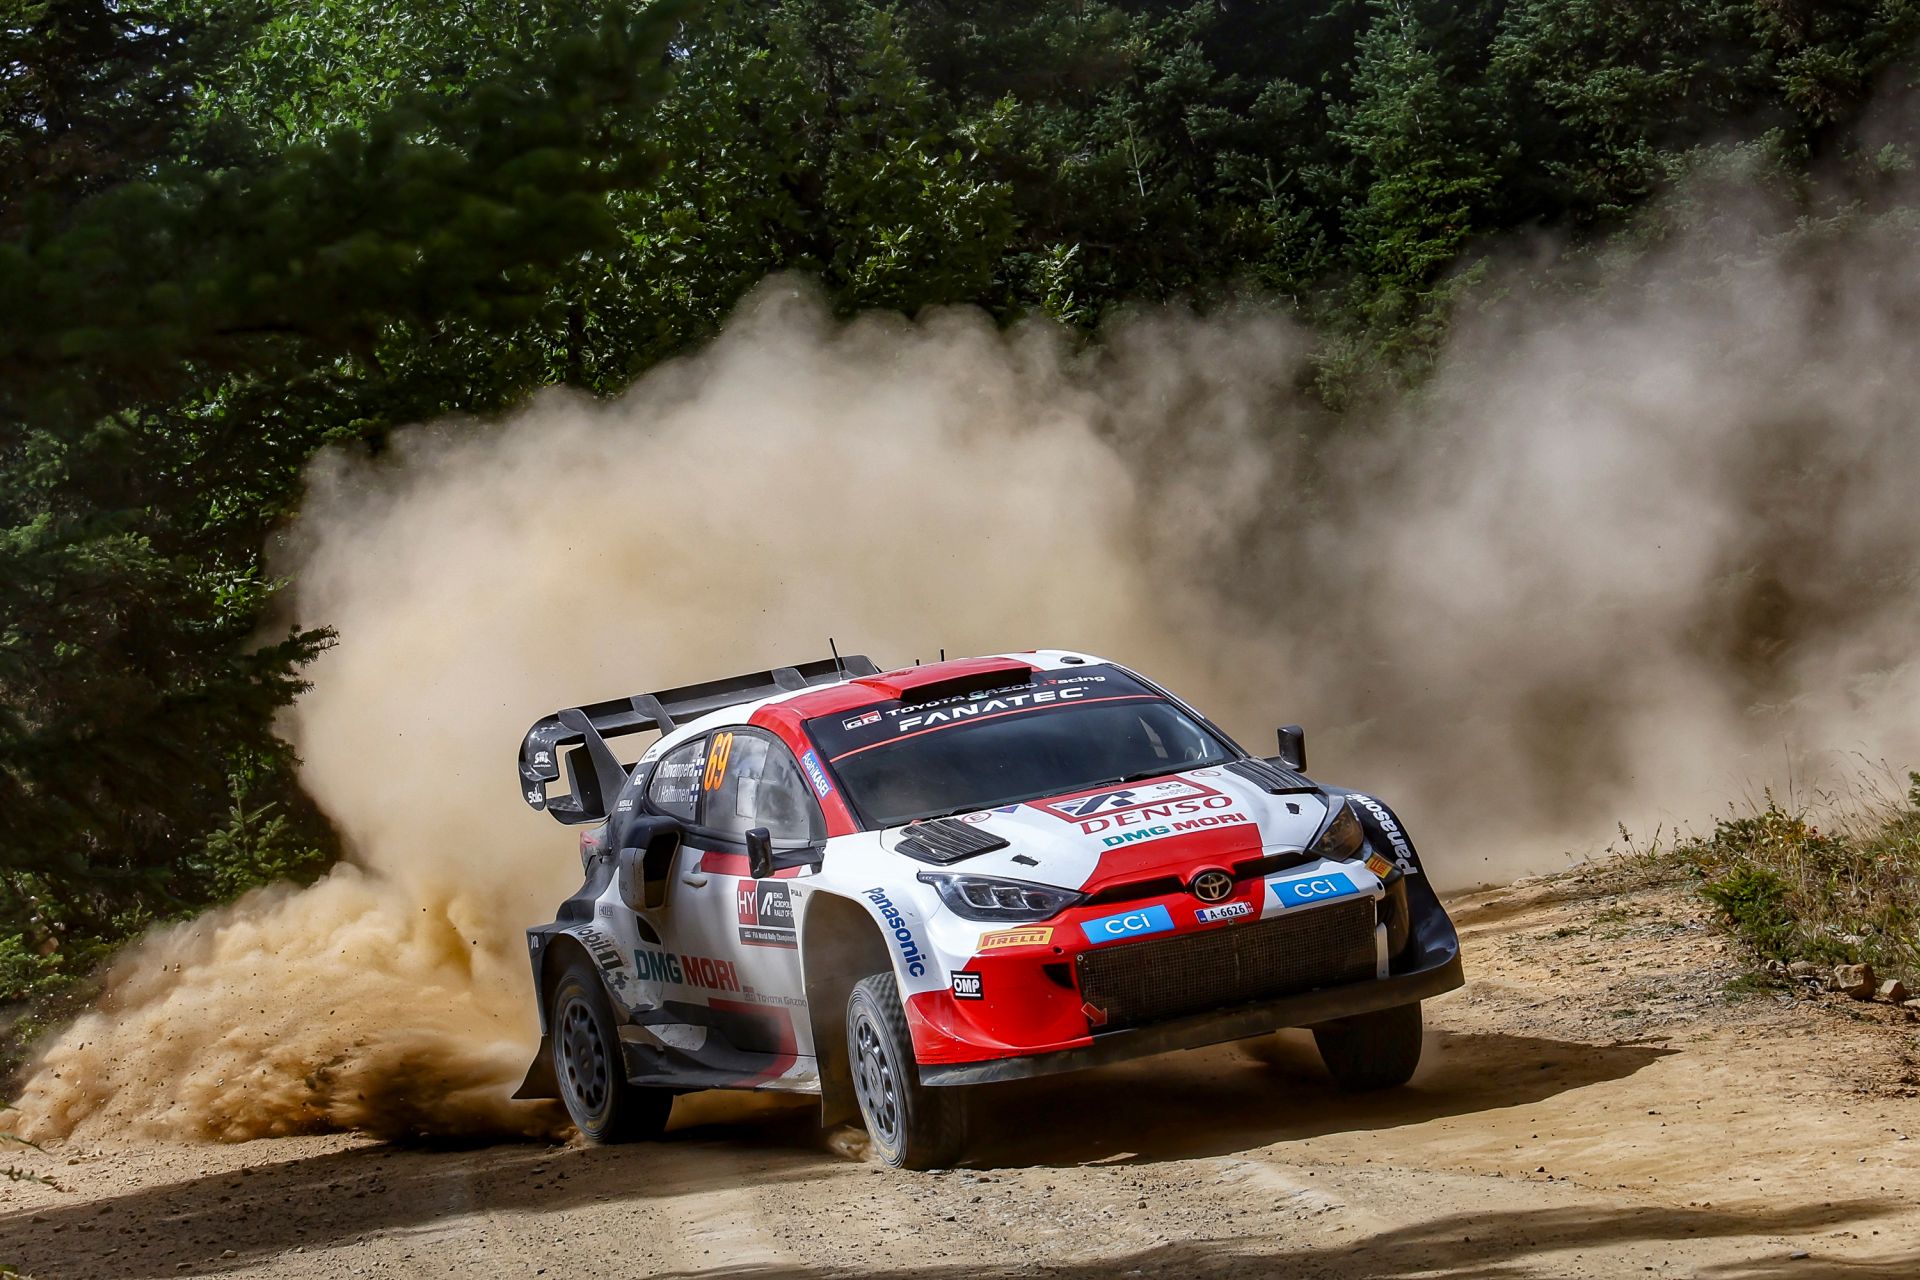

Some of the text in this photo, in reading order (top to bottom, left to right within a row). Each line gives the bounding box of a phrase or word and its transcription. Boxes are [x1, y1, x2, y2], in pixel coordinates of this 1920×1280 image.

[899, 687, 1084, 731] FANATEC
[704, 733, 733, 791] 69
[1080, 796, 1233, 835] DENSO
[1102, 812, 1247, 847] DMG MORI
[1210, 904, 1245, 919] A-6626
[862, 887, 926, 978] Panasonic
[982, 930, 1047, 947] PIRELLI
[634, 949, 683, 984] DMG
[681, 954, 741, 993] MORI
[953, 979, 980, 993] OMP
